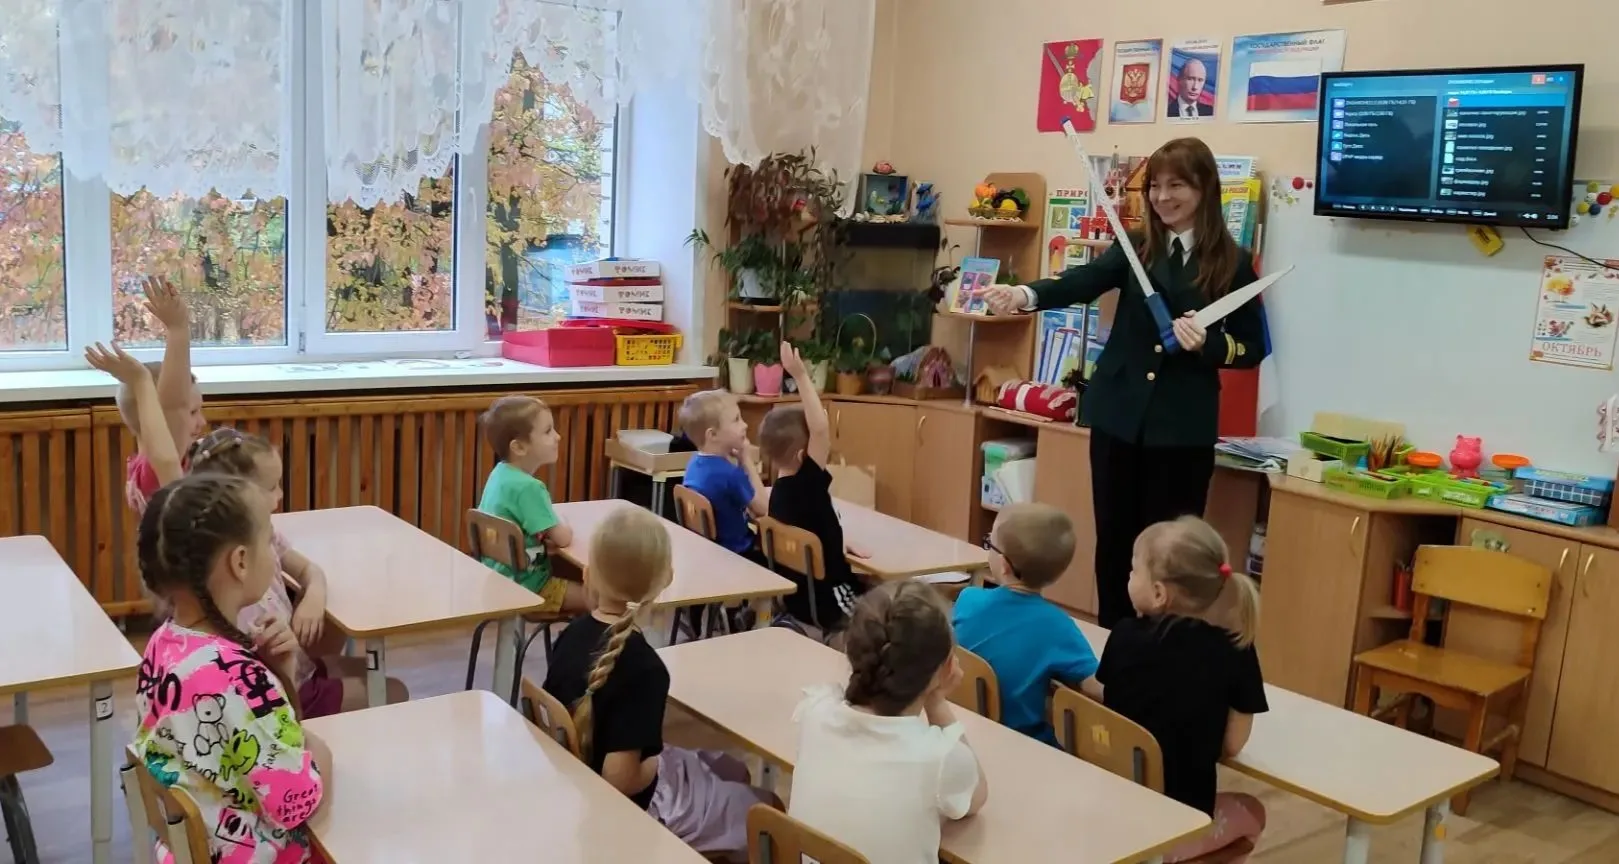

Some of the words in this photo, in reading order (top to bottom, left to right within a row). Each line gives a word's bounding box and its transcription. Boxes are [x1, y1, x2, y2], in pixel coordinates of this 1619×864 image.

[1542, 341, 1602, 357] ОКТЯБРЬ
[277, 798, 316, 816] things
[282, 811, 306, 823] are
